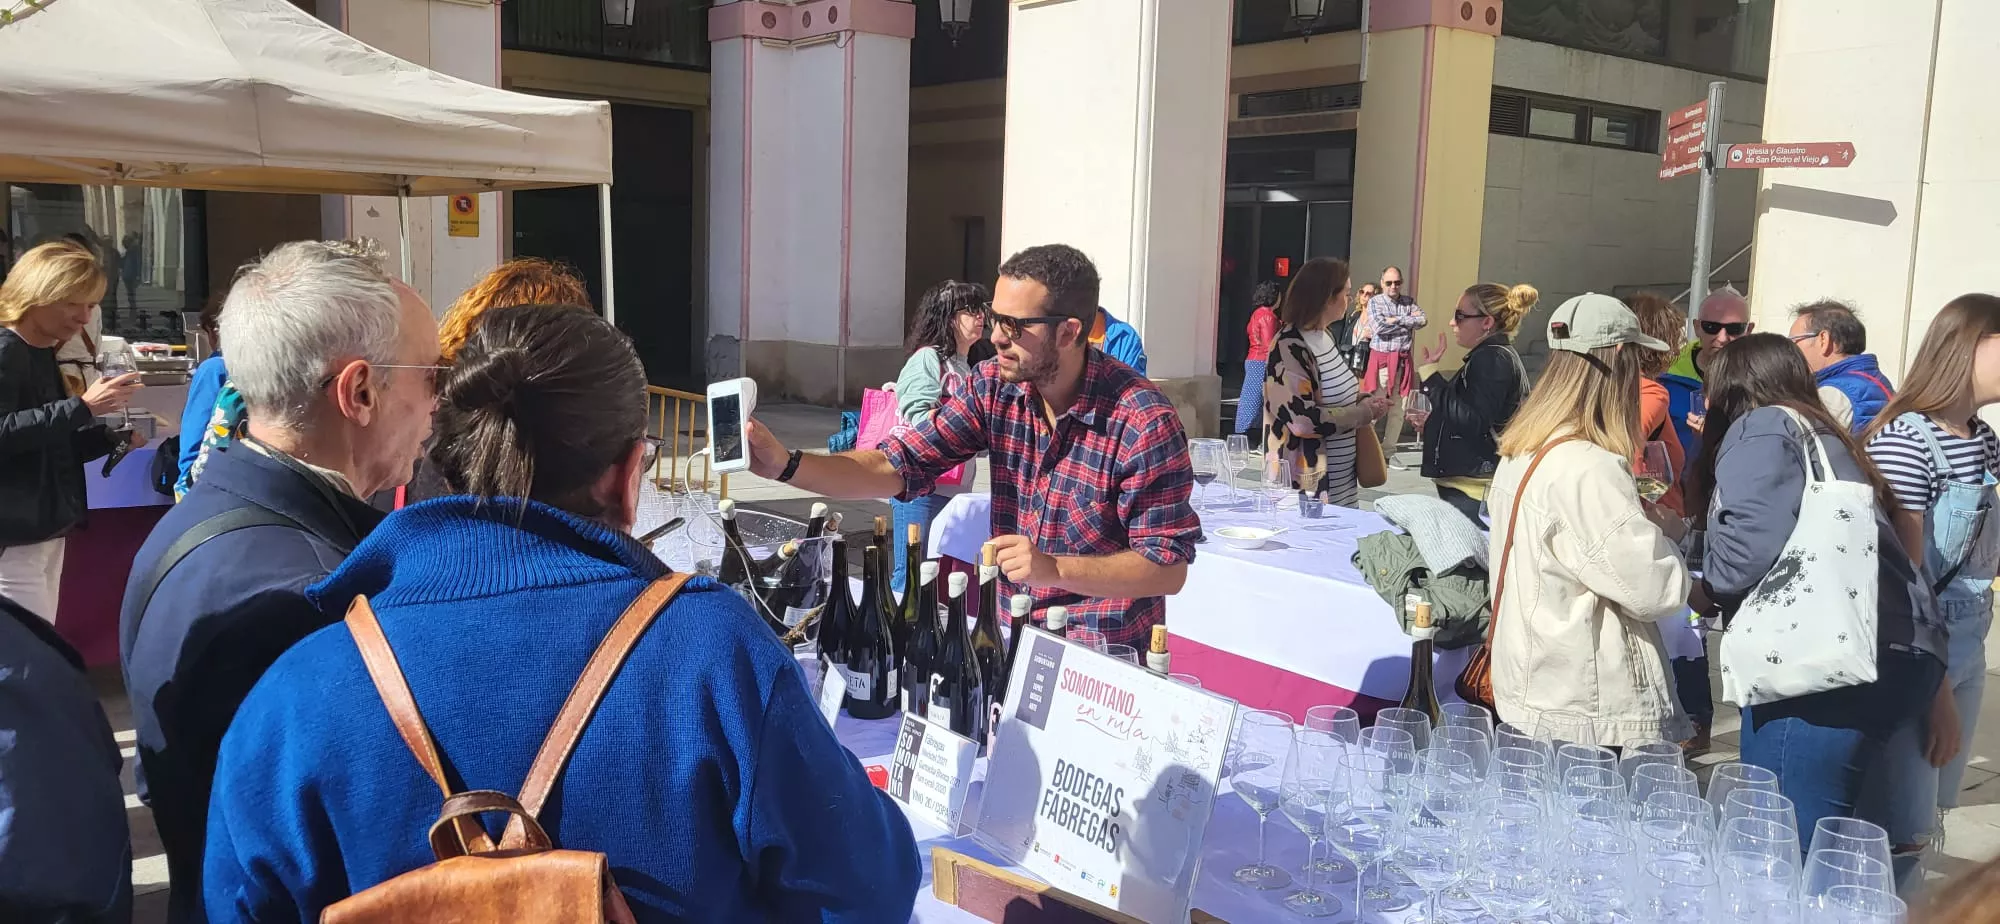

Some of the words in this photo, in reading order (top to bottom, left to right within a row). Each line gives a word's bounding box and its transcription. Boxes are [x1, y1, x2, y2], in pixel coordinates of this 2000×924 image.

[1745, 155, 1755, 164] de
[1771, 155, 1793, 163] Pedro
[1793, 155, 1801, 163] el
[1801, 155, 1820, 165] Viejo
[1746, 147, 1769, 157] Iglesia
[1776, 147, 1806, 155] Claustro
[1060, 667, 1135, 717] SOMONTANO
[1077, 703, 1102, 721] en
[1106, 708, 1150, 741] ruta
[1051, 758, 1124, 818] BODEGAS
[1039, 788, 1120, 854] FÁBREGAS
